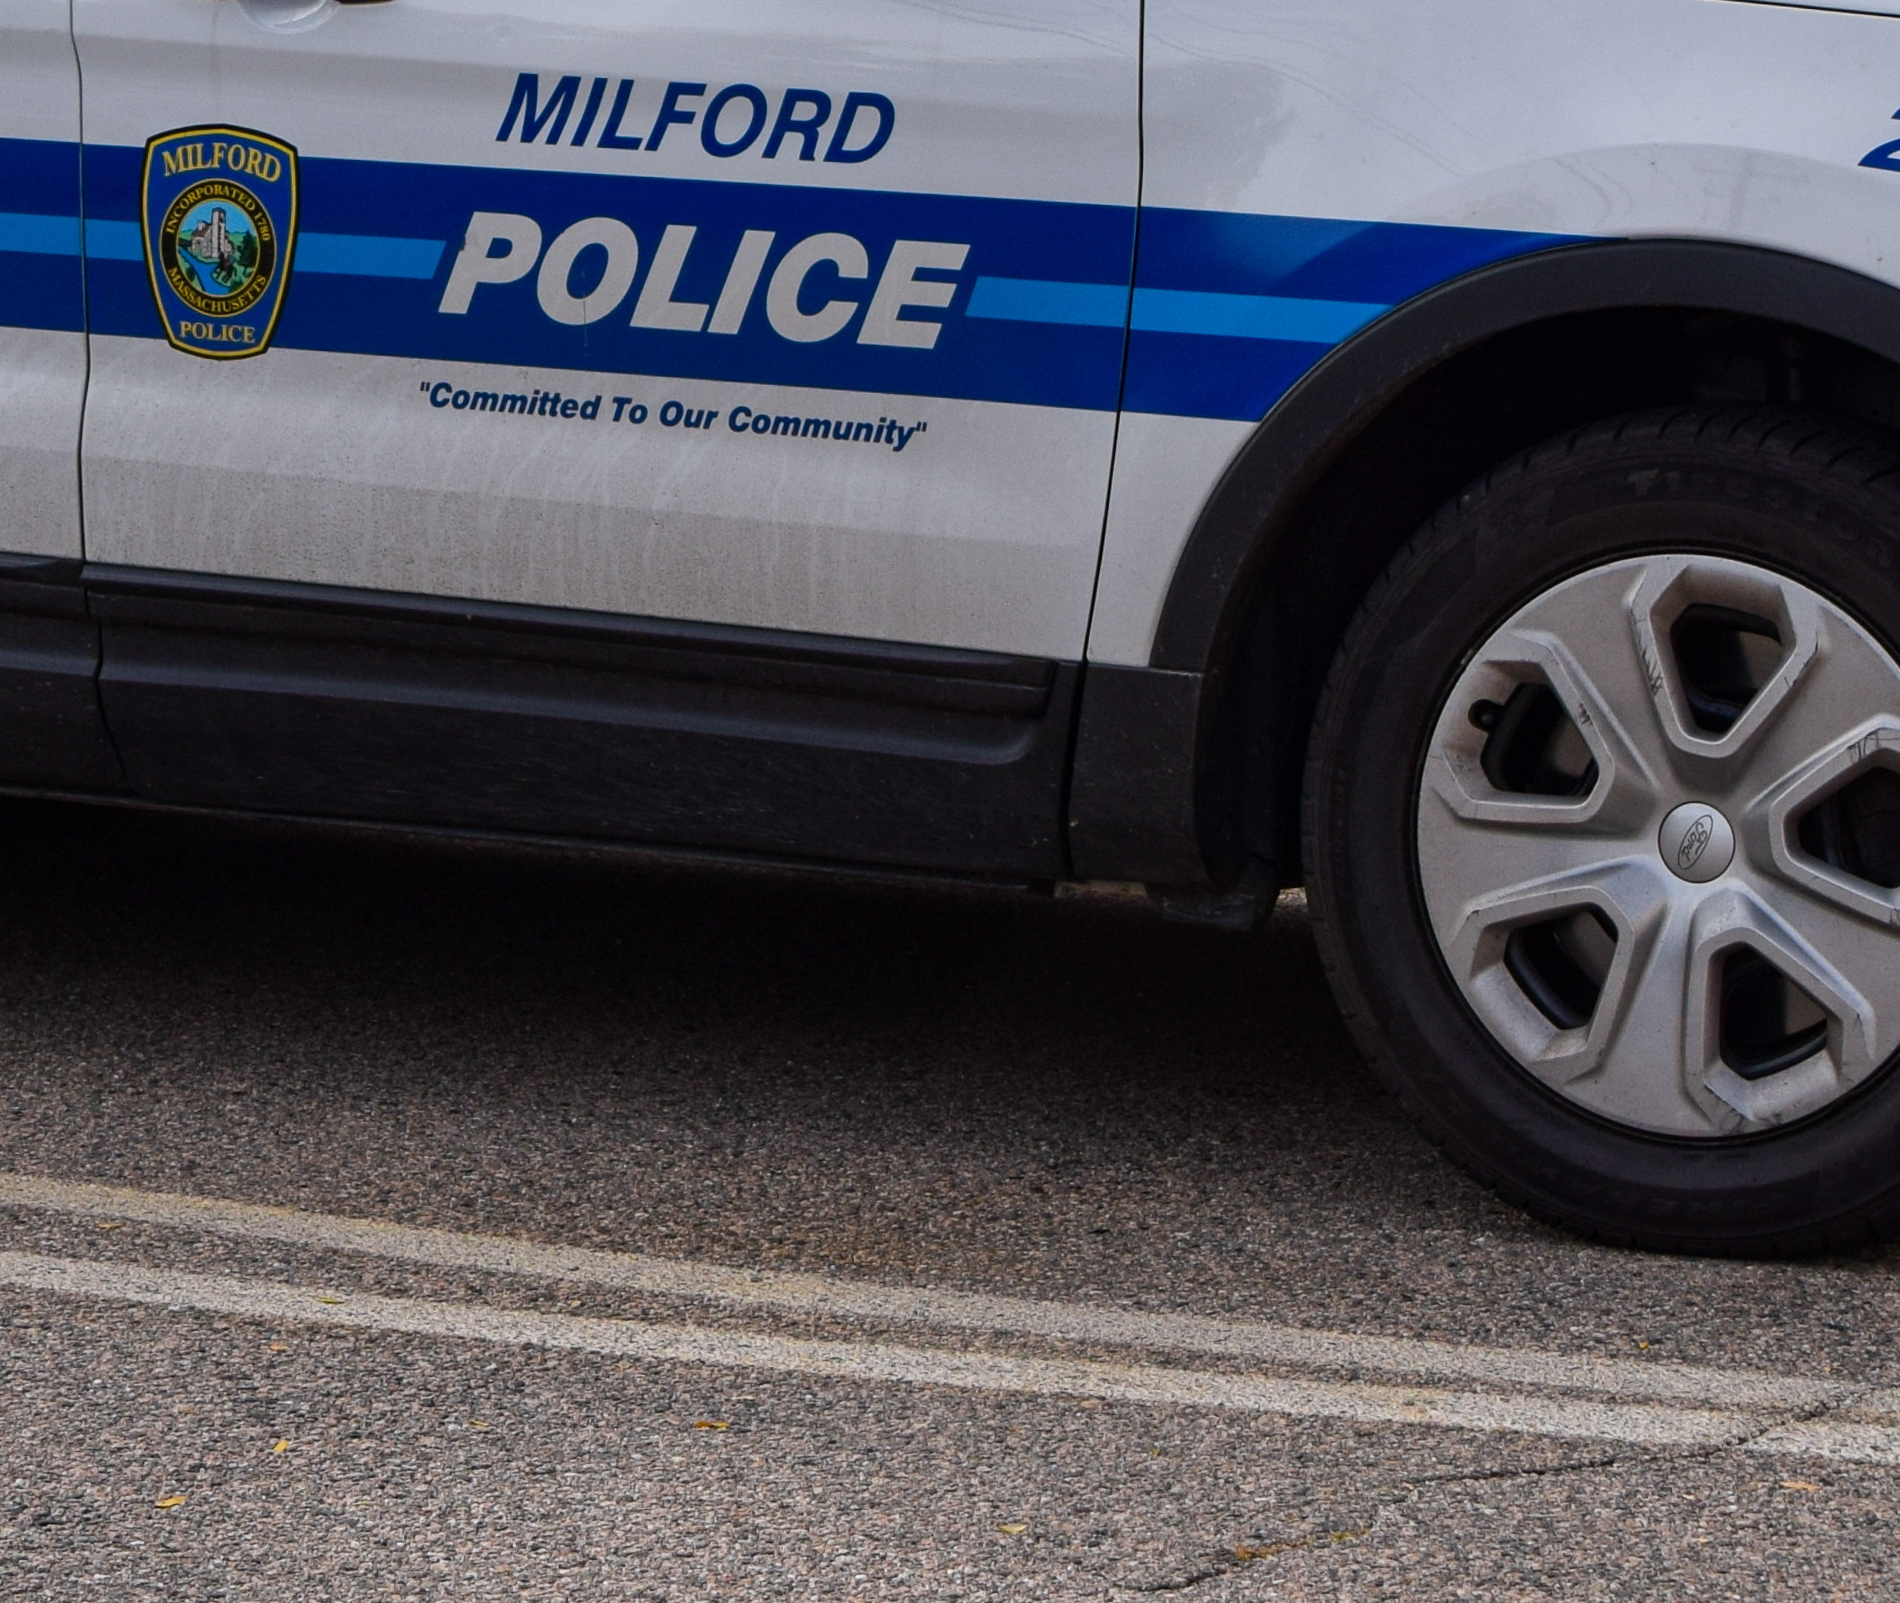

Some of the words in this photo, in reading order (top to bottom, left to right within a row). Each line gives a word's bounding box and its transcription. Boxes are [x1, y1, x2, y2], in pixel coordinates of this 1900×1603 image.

[495, 72, 896, 165] MILFORD
[162, 142, 282, 182] MILFORD
[166, 184, 256, 234] INCORPORATED
[253, 210, 271, 241] 1780
[167, 267, 267, 313] MASSACHUSETTS
[437, 210, 971, 350] POLICE
[180, 321, 256, 343] POLICE
[419, 381, 599, 422] "Committed
[611, 397, 648, 425] To
[659, 401, 718, 431] Our
[728, 405, 927, 452] Community"
[1681, 821, 1708, 862] Ford
